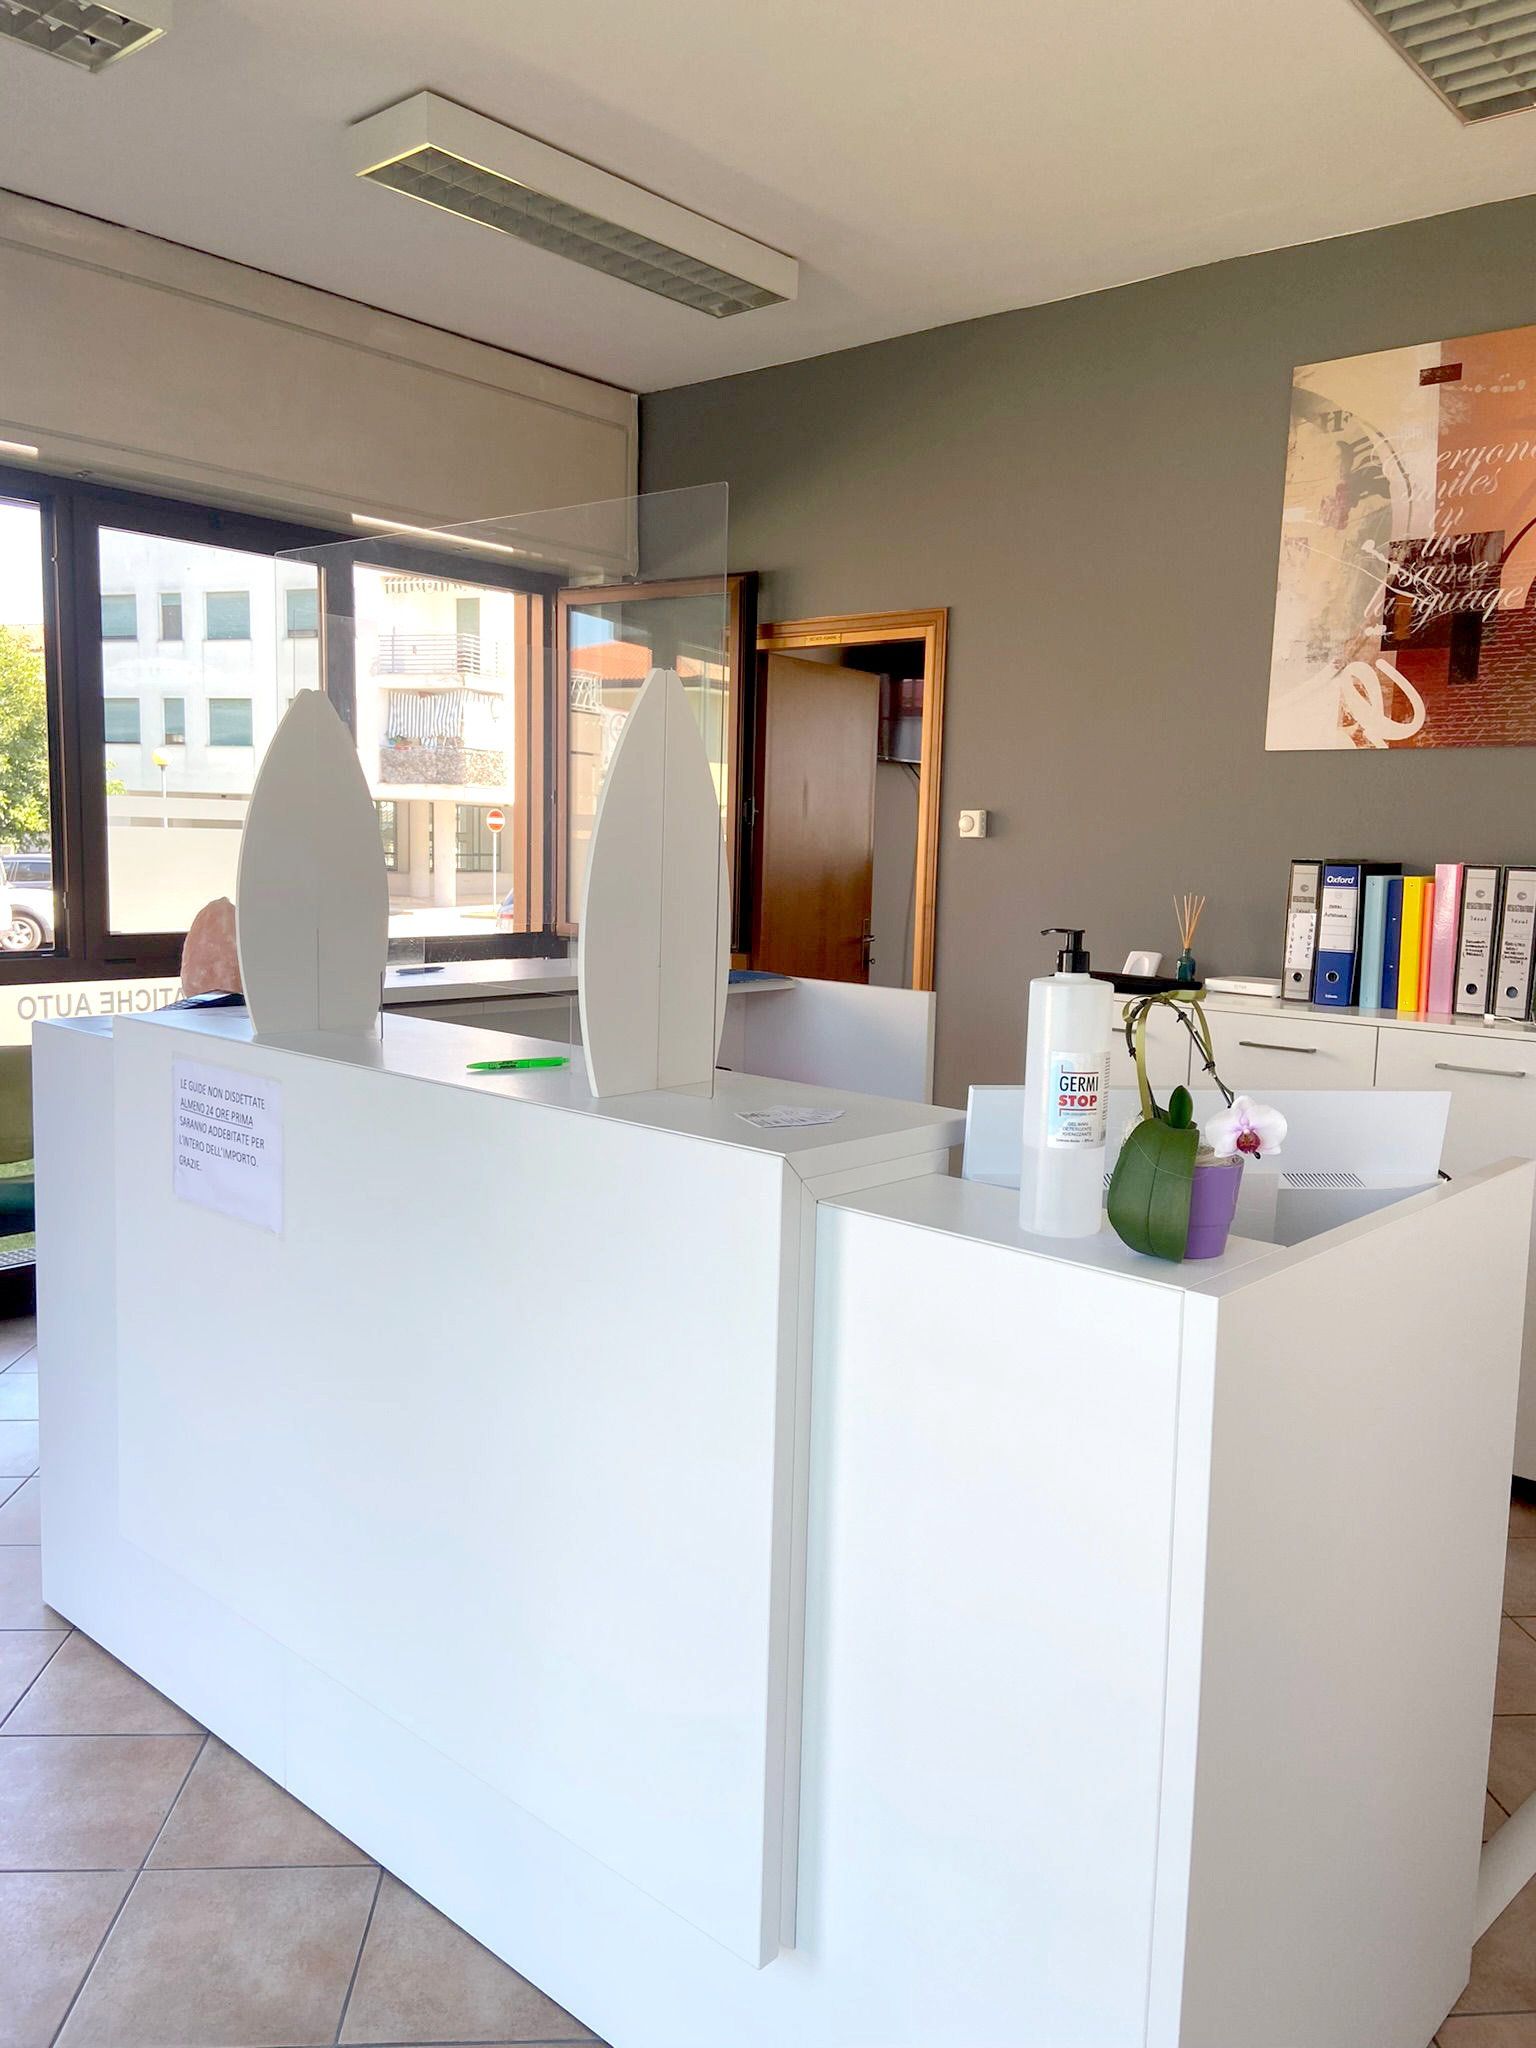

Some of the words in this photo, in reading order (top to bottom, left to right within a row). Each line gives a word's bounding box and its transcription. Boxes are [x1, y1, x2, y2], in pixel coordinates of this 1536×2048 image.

[1420, 519, 1472, 557] the
[1399, 561, 1489, 589] same
[1327, 875, 1355, 885] Oxford
[180, 1078, 188, 1090] LE
[188, 1080, 206, 1096] GUIDE
[207, 1085, 223, 1099] NON
[224, 1089, 265, 1110] DISDETTATE
[1060, 1076, 1098, 1092] GERMI
[180, 1097, 205, 1114] ALMENO
[205, 1104, 214, 1116] 24
[215, 1107, 230, 1121] ORE
[231, 1111, 253, 1127] PRIMA
[1059, 1095, 1097, 1107] STOP
[179, 1115, 207, 1134] SARANNO
[208, 1125, 249, 1146] ADDEBITATE
[251, 1136, 265, 1149] PER
[179, 1134, 205, 1152] L'INTERO
